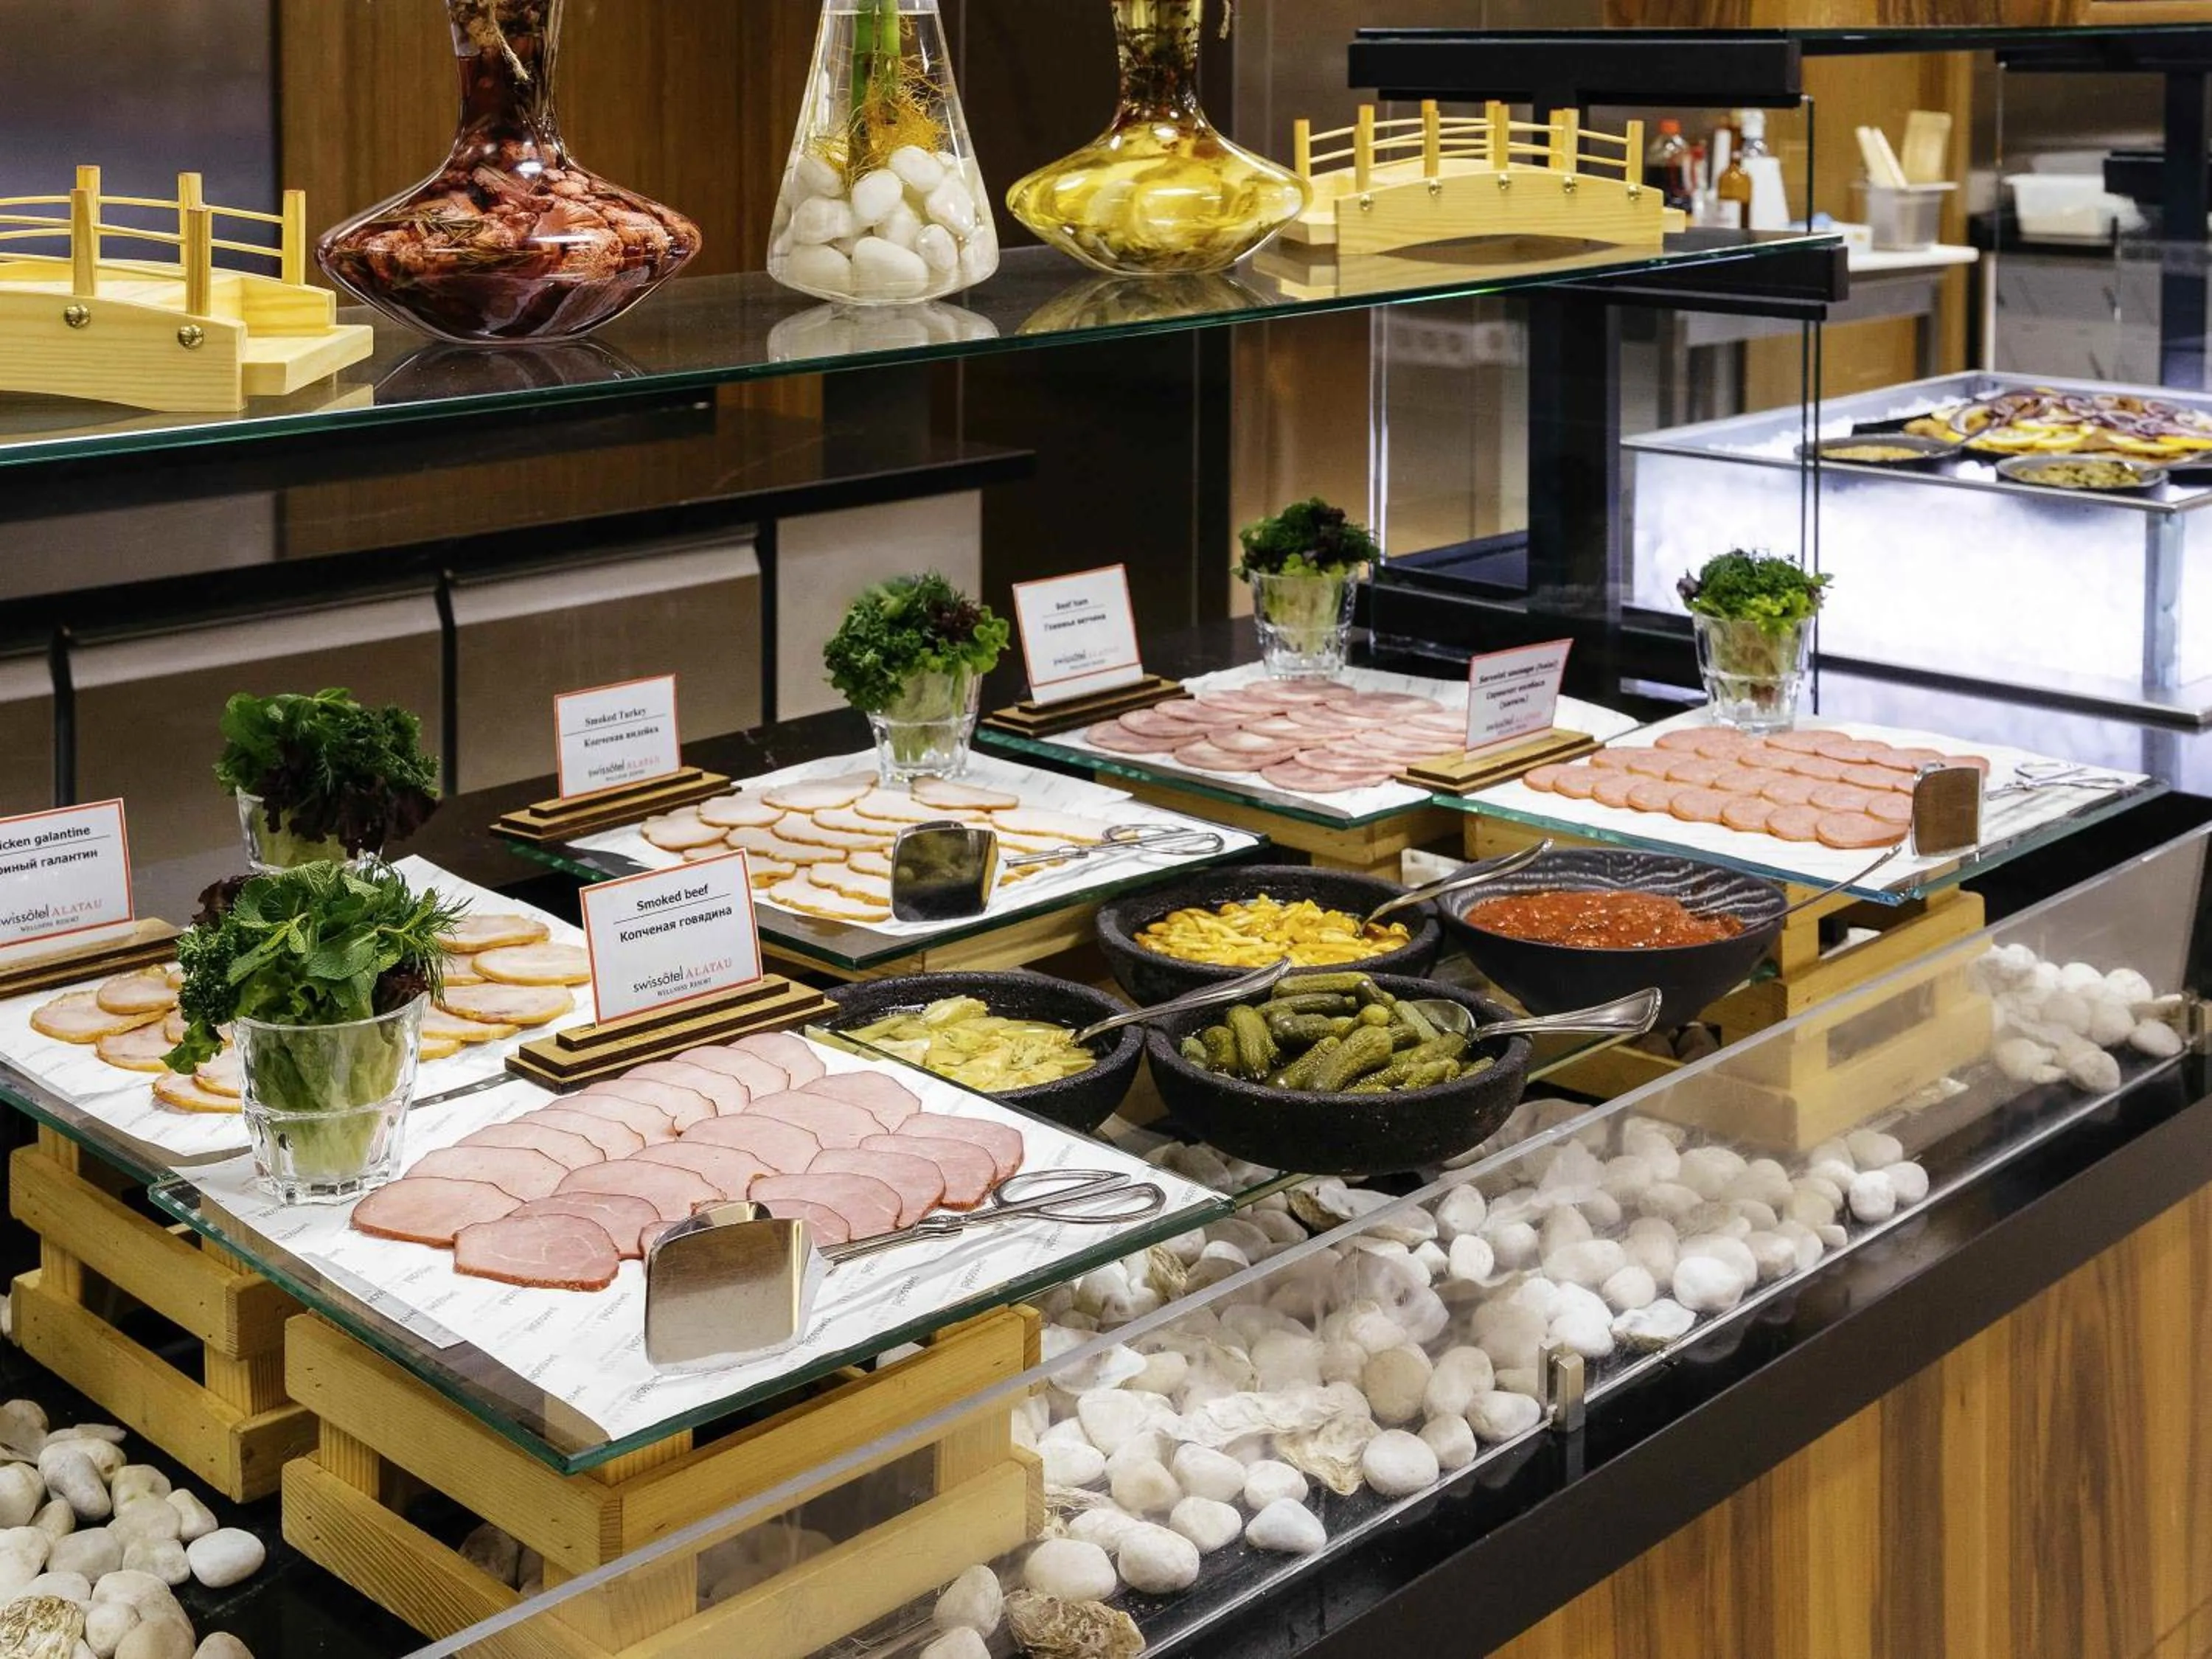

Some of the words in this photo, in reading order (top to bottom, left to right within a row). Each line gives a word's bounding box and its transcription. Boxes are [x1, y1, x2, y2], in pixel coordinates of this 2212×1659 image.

[585, 712, 616, 726] Smoked
[619, 707, 647, 720] Turkey
[0, 837, 31, 850] icken
[35, 826, 91, 846] galantine
[0, 858, 38, 875] риный
[41, 849, 98, 868] галантин
[636, 889, 682, 911] Smoked
[684, 883, 709, 900] beef
[0, 903, 49, 925] wissôtel
[51, 899, 102, 917] ALATAU
[620, 920, 676, 942] Копченая
[679, 905, 732, 927] говядина
[686, 957, 732, 979] ALATAU
